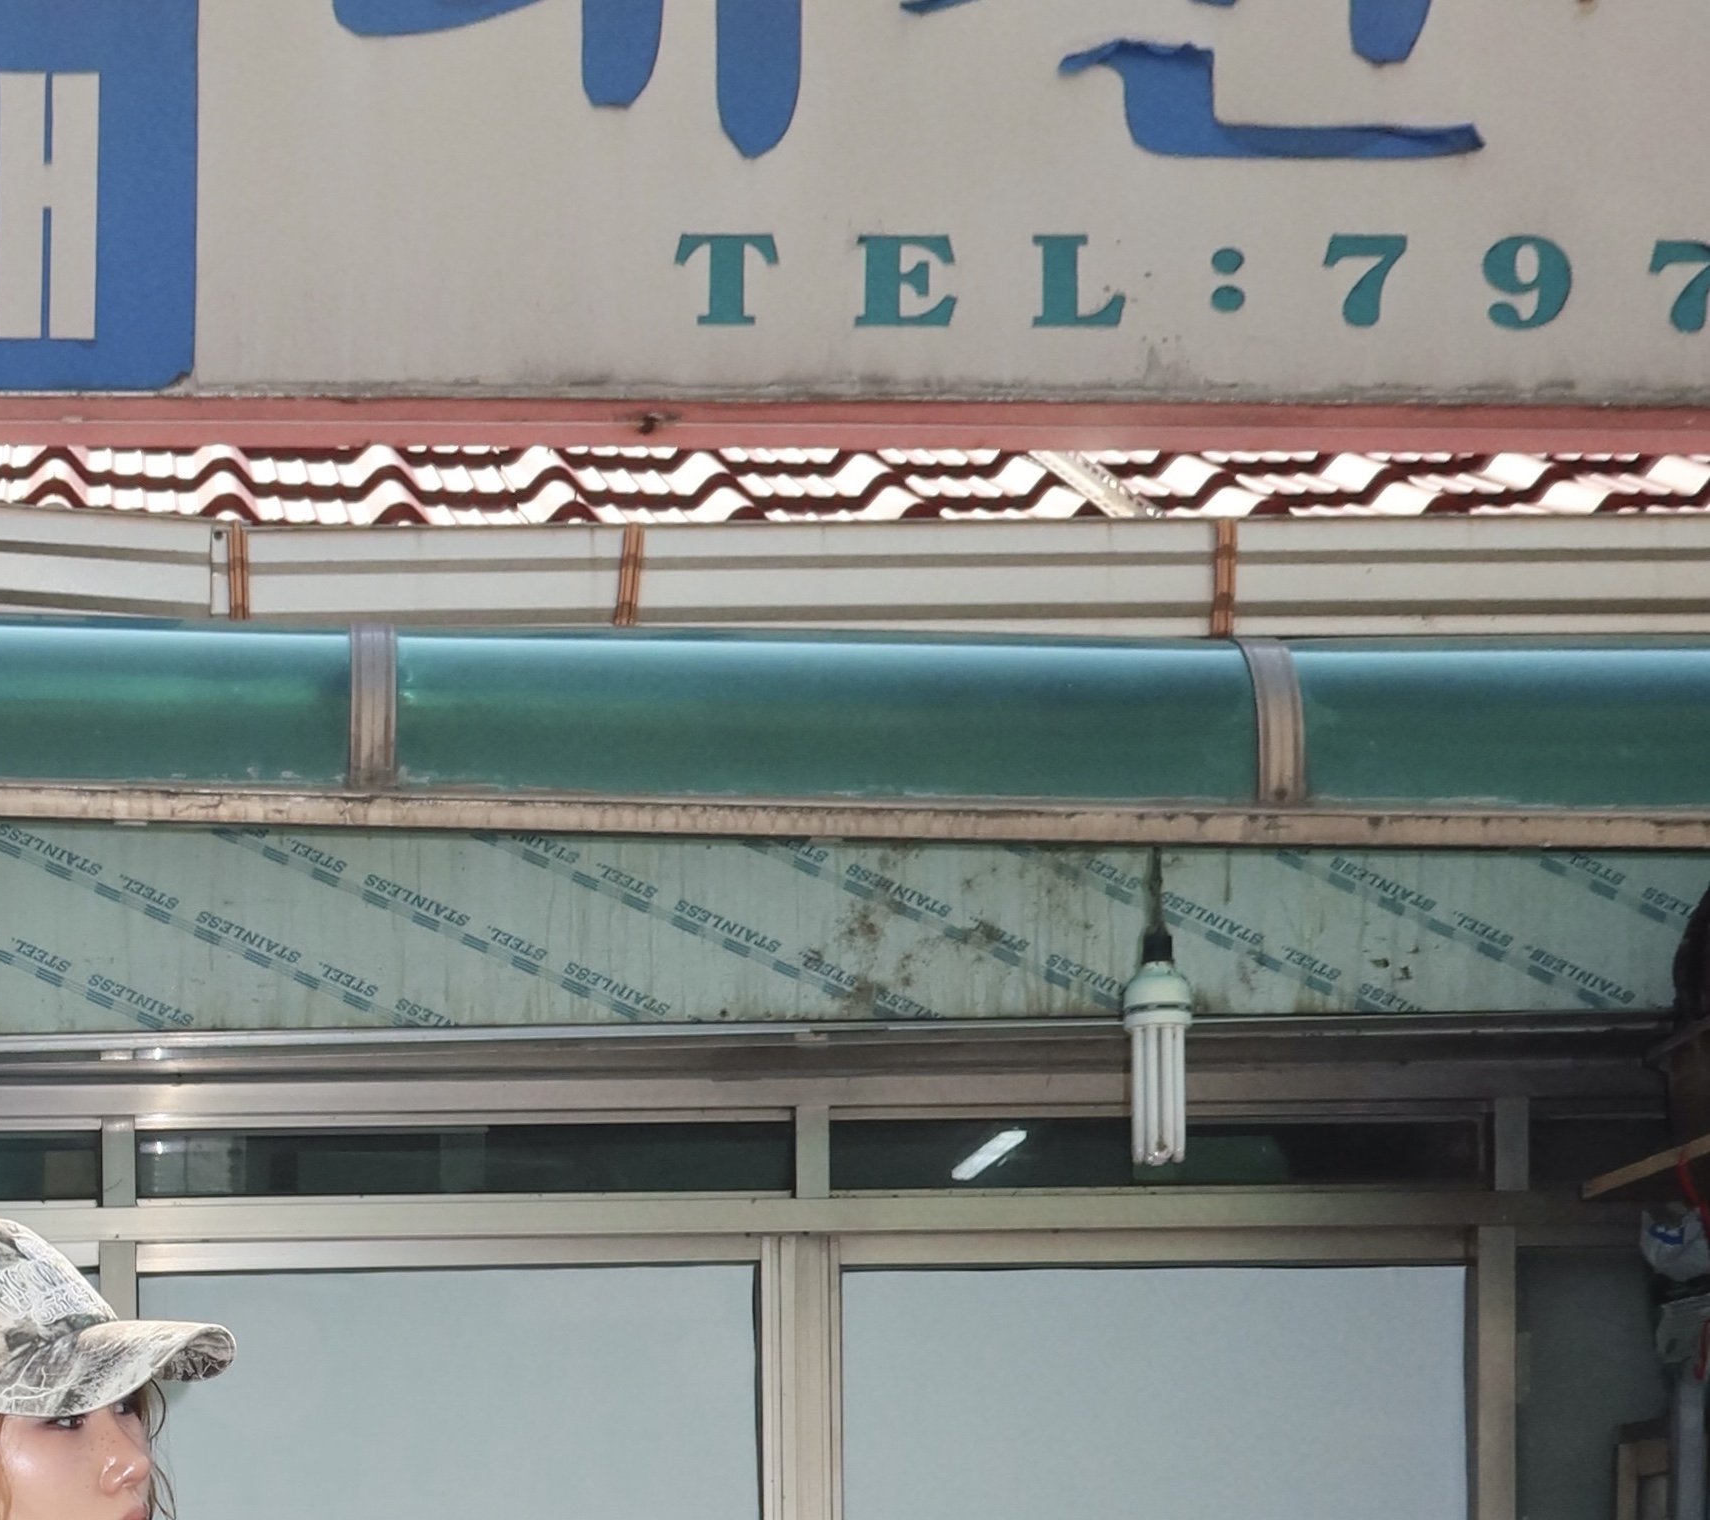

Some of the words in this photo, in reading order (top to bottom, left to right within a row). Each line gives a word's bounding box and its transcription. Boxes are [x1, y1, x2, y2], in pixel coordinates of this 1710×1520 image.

[364, 874, 472, 927] STAINLESS
[674, 899, 782, 954] STAINLESS
[195, 910, 302, 964] STAINLESS
[88, 974, 195, 1028] STAINLESS
[564, 962, 671, 1017] STAINLESS
